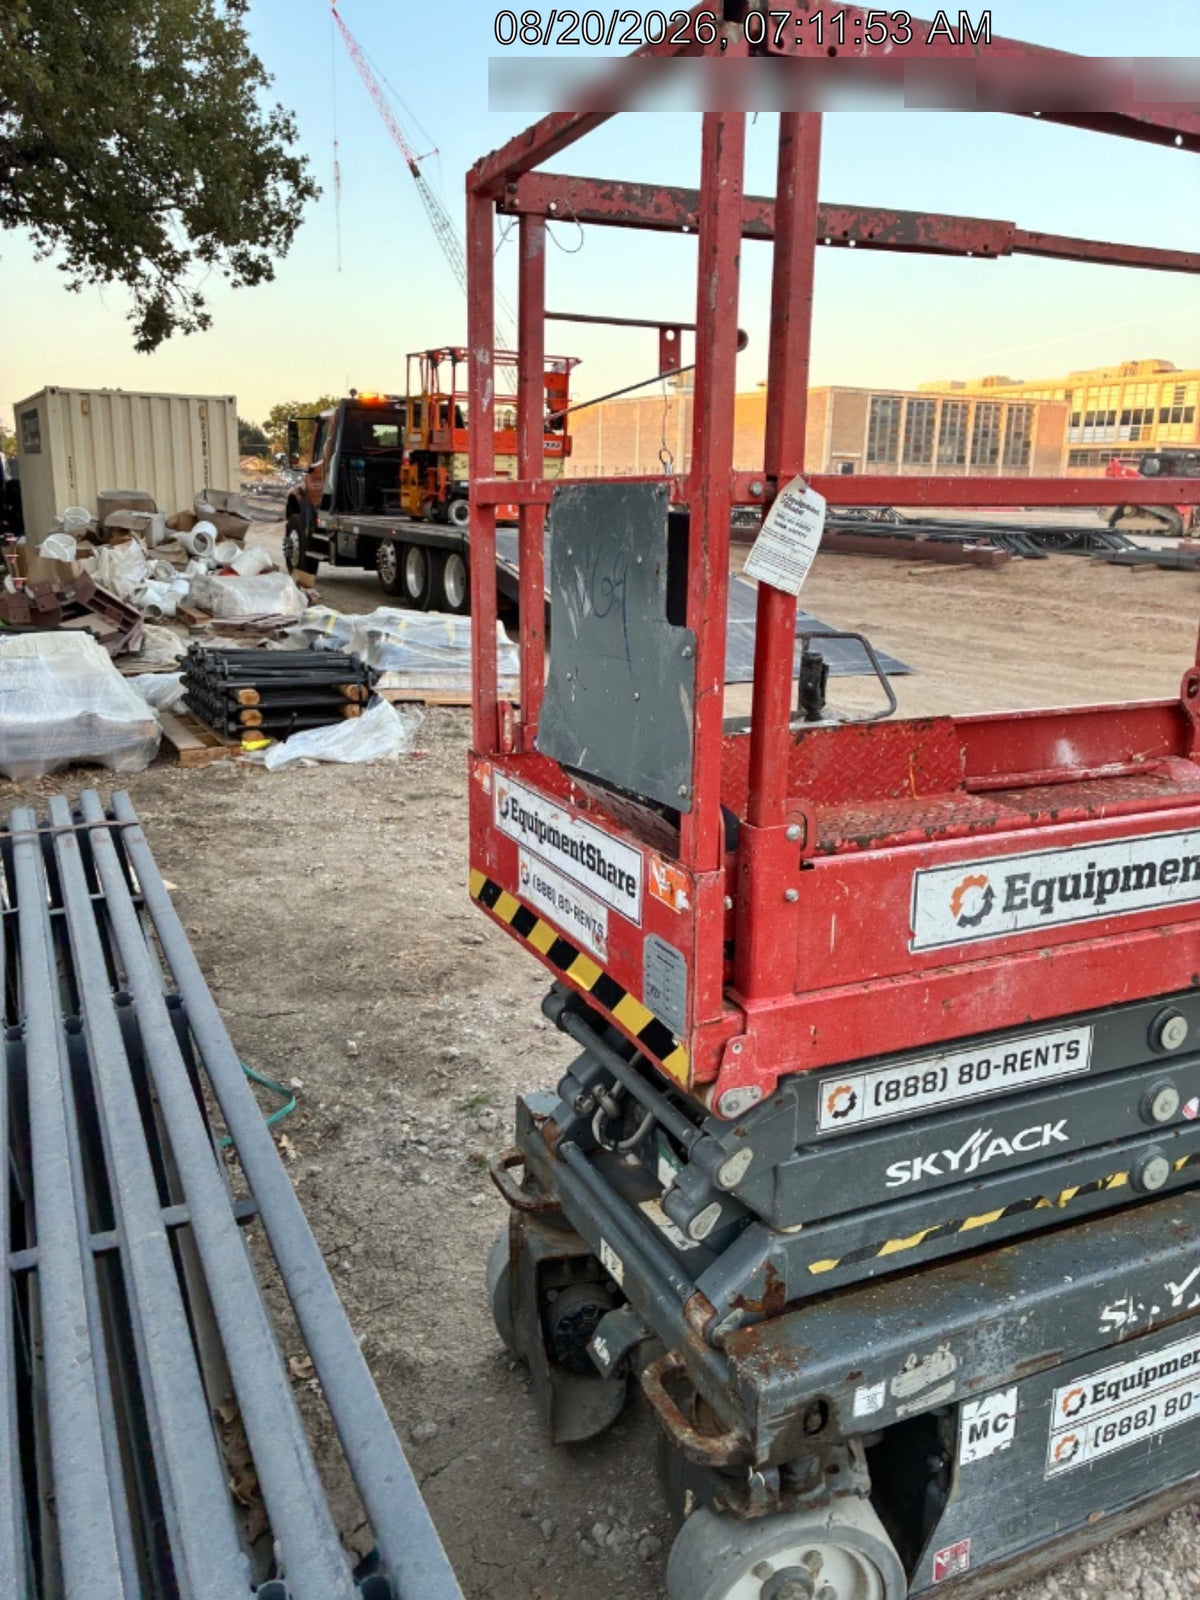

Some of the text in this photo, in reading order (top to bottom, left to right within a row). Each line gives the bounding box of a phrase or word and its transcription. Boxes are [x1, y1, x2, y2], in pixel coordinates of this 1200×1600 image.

[510, 797, 636, 898] EquipmentShare
[873, 1039, 1081, 1107] (888) 80-RENTS
[885, 1119, 1069, 1187] SKYJACK
[1093, 1404, 1157, 1448] (888)
